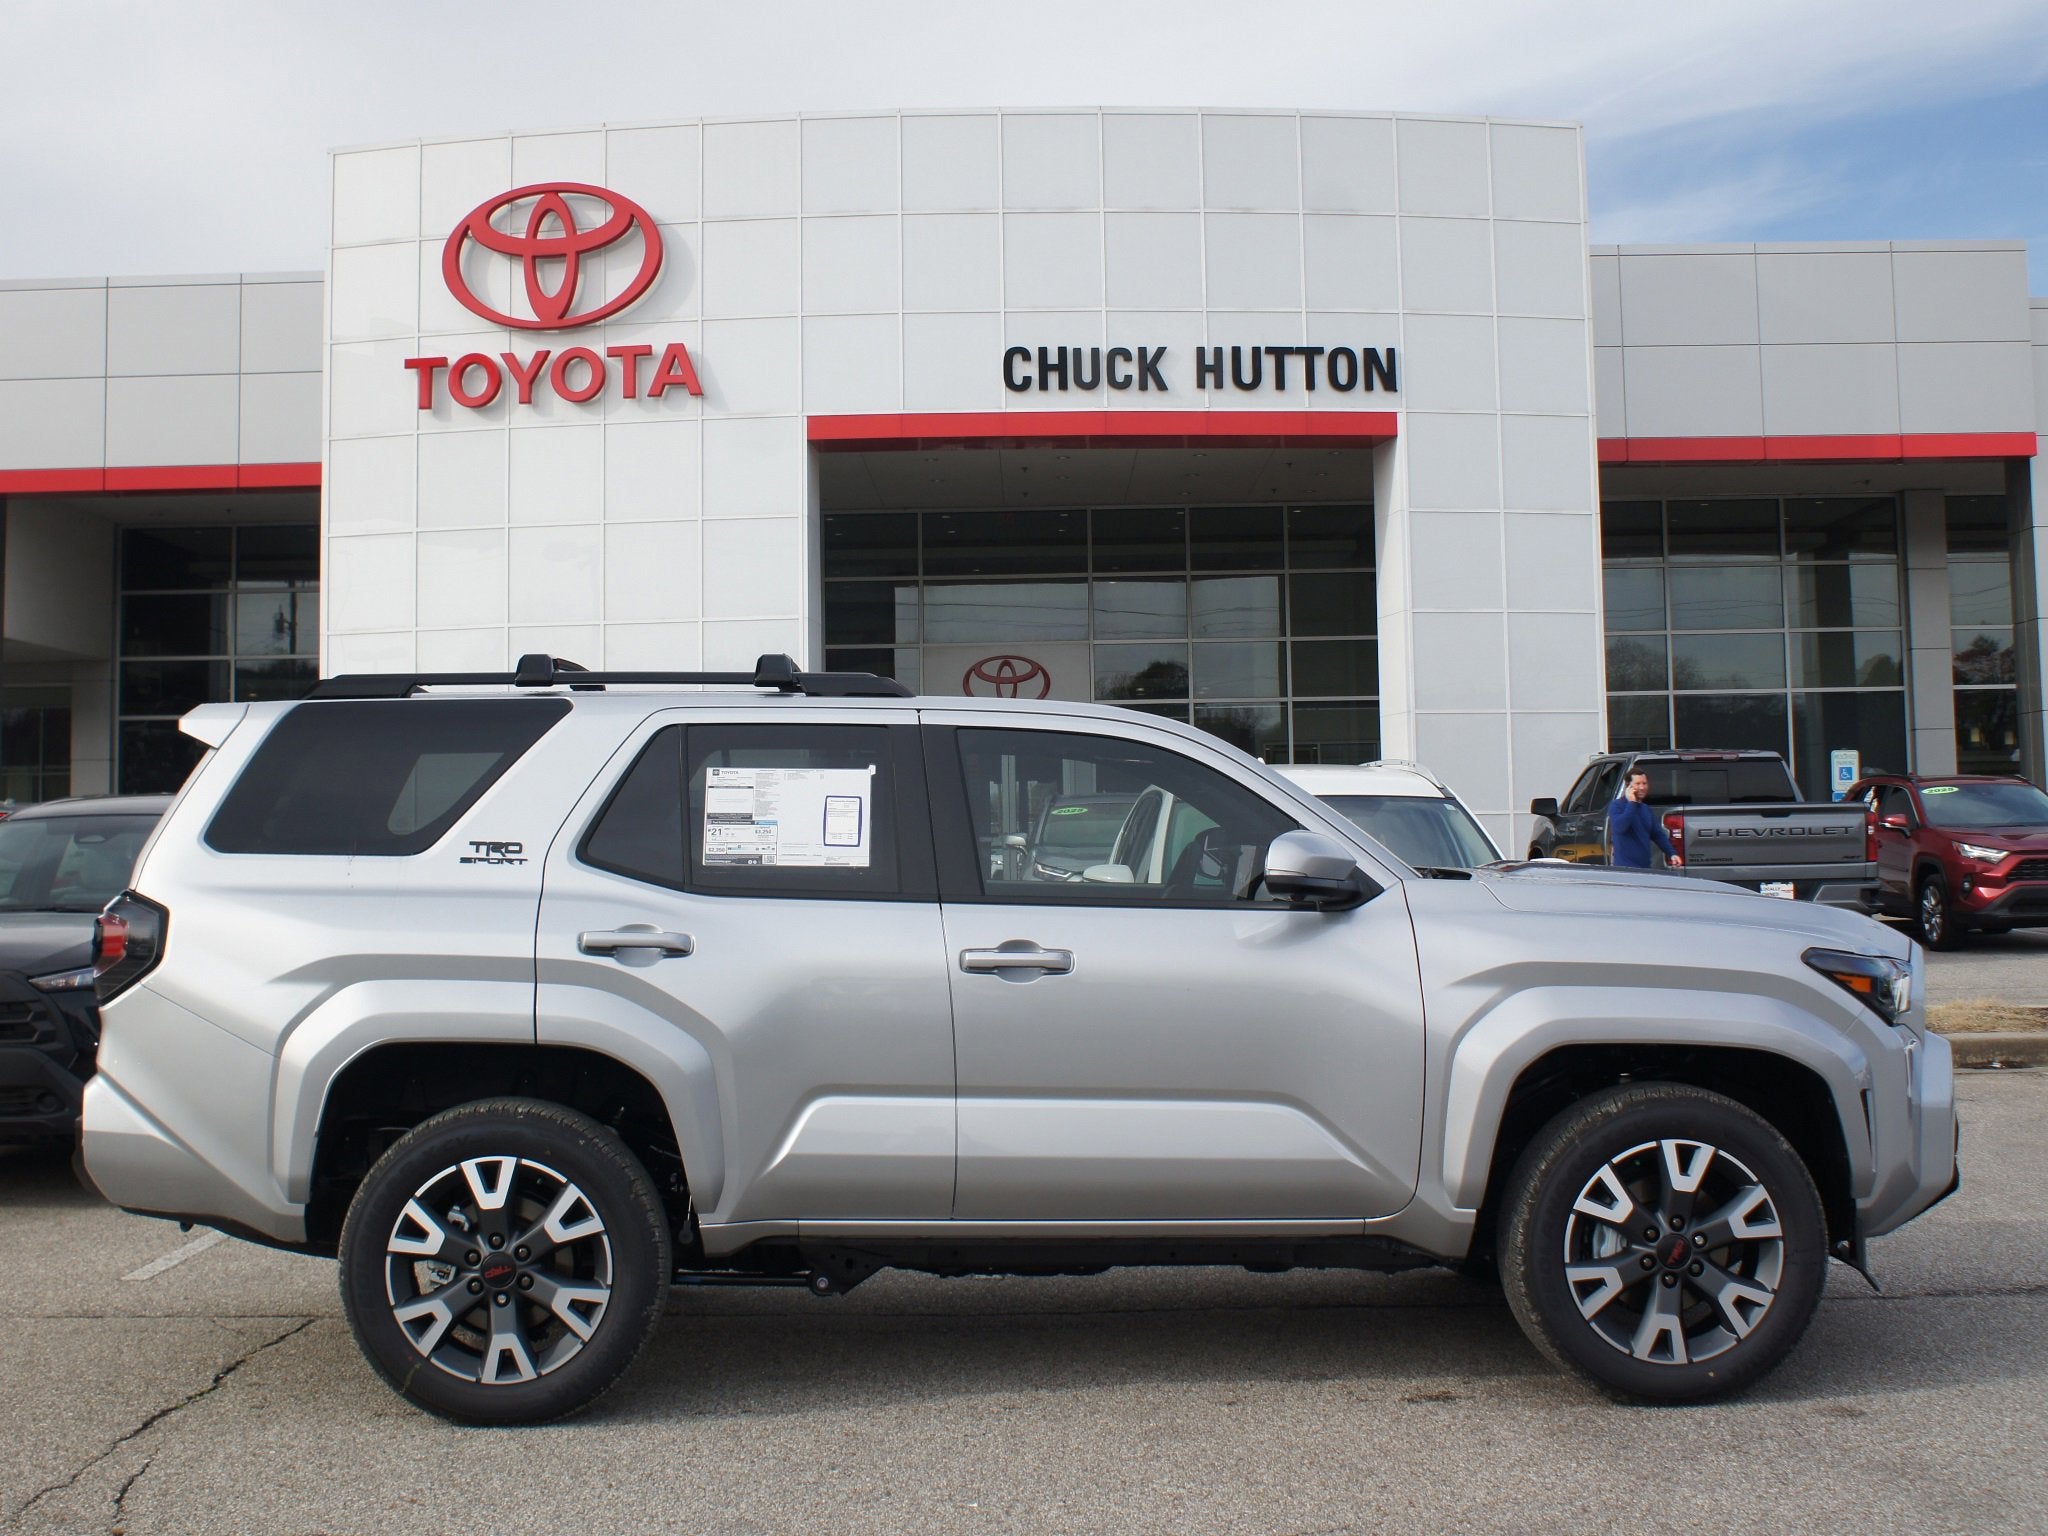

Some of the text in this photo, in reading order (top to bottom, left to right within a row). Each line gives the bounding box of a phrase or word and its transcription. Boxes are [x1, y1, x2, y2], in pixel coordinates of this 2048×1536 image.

[404, 342, 704, 410] TOYOTA
[1002, 345, 1398, 393] CHUCK HUTTON
[711, 828, 722, 836] 21
[1697, 826, 1855, 838] CHEVROLET
[469, 841, 523, 857] TRD
[459, 857, 529, 865] SPORT
